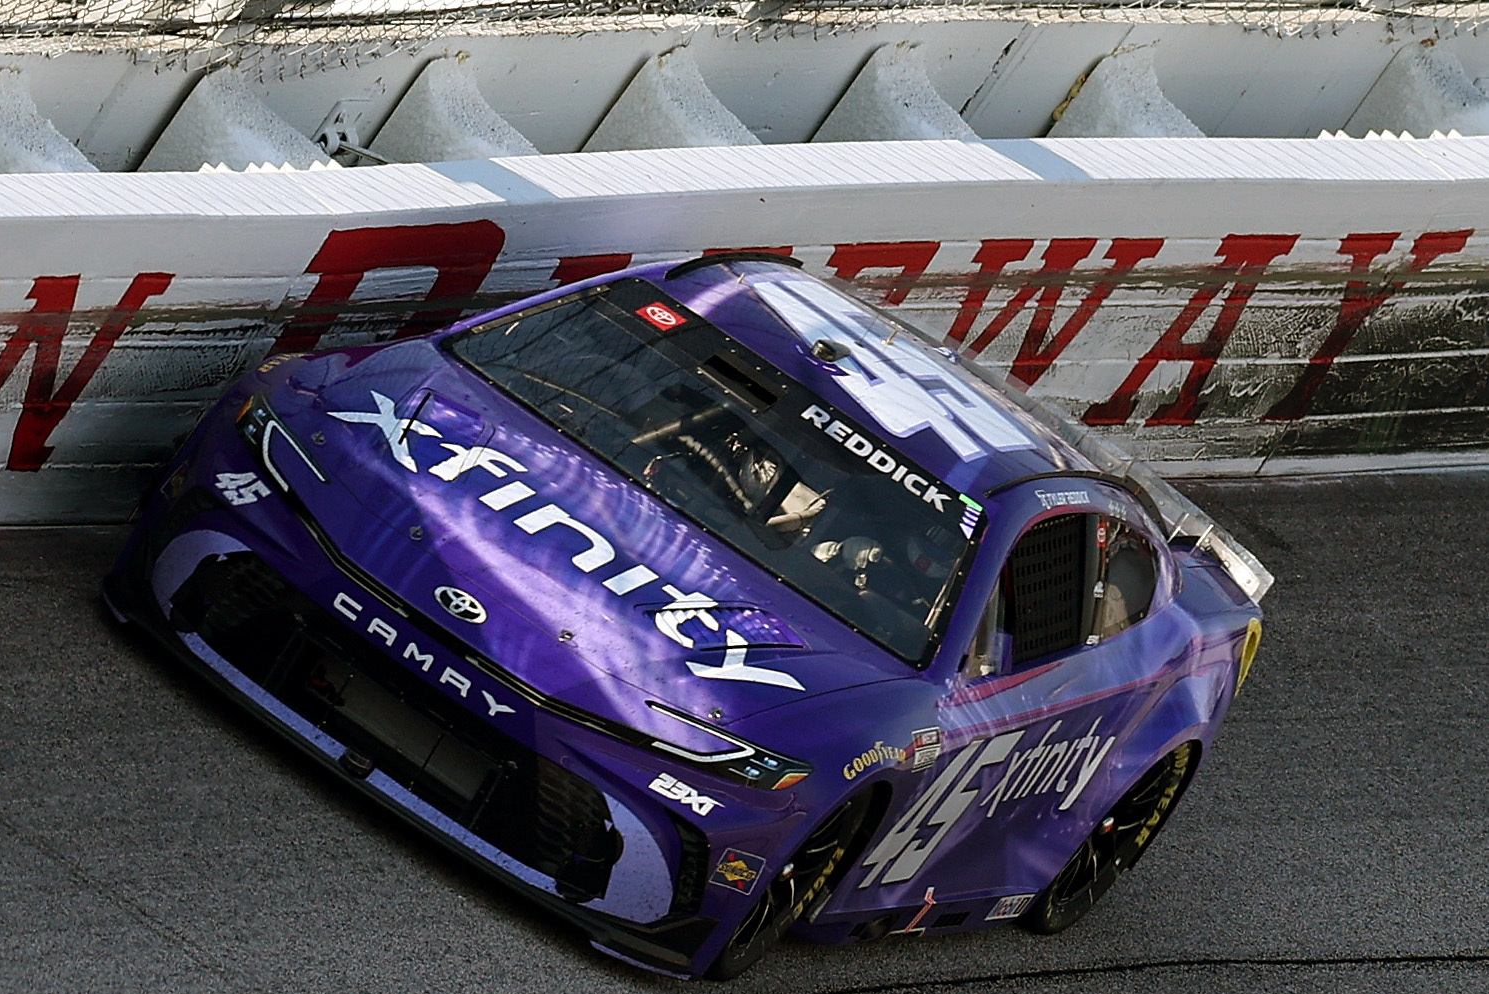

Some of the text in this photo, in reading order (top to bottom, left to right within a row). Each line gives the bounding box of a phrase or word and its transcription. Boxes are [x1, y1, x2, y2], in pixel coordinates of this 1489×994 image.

[214, 466, 273, 507] 45
[800, 403, 953, 514] REDDICK
[333, 591, 516, 717] CAMRY
[859, 729, 1027, 889] 45
